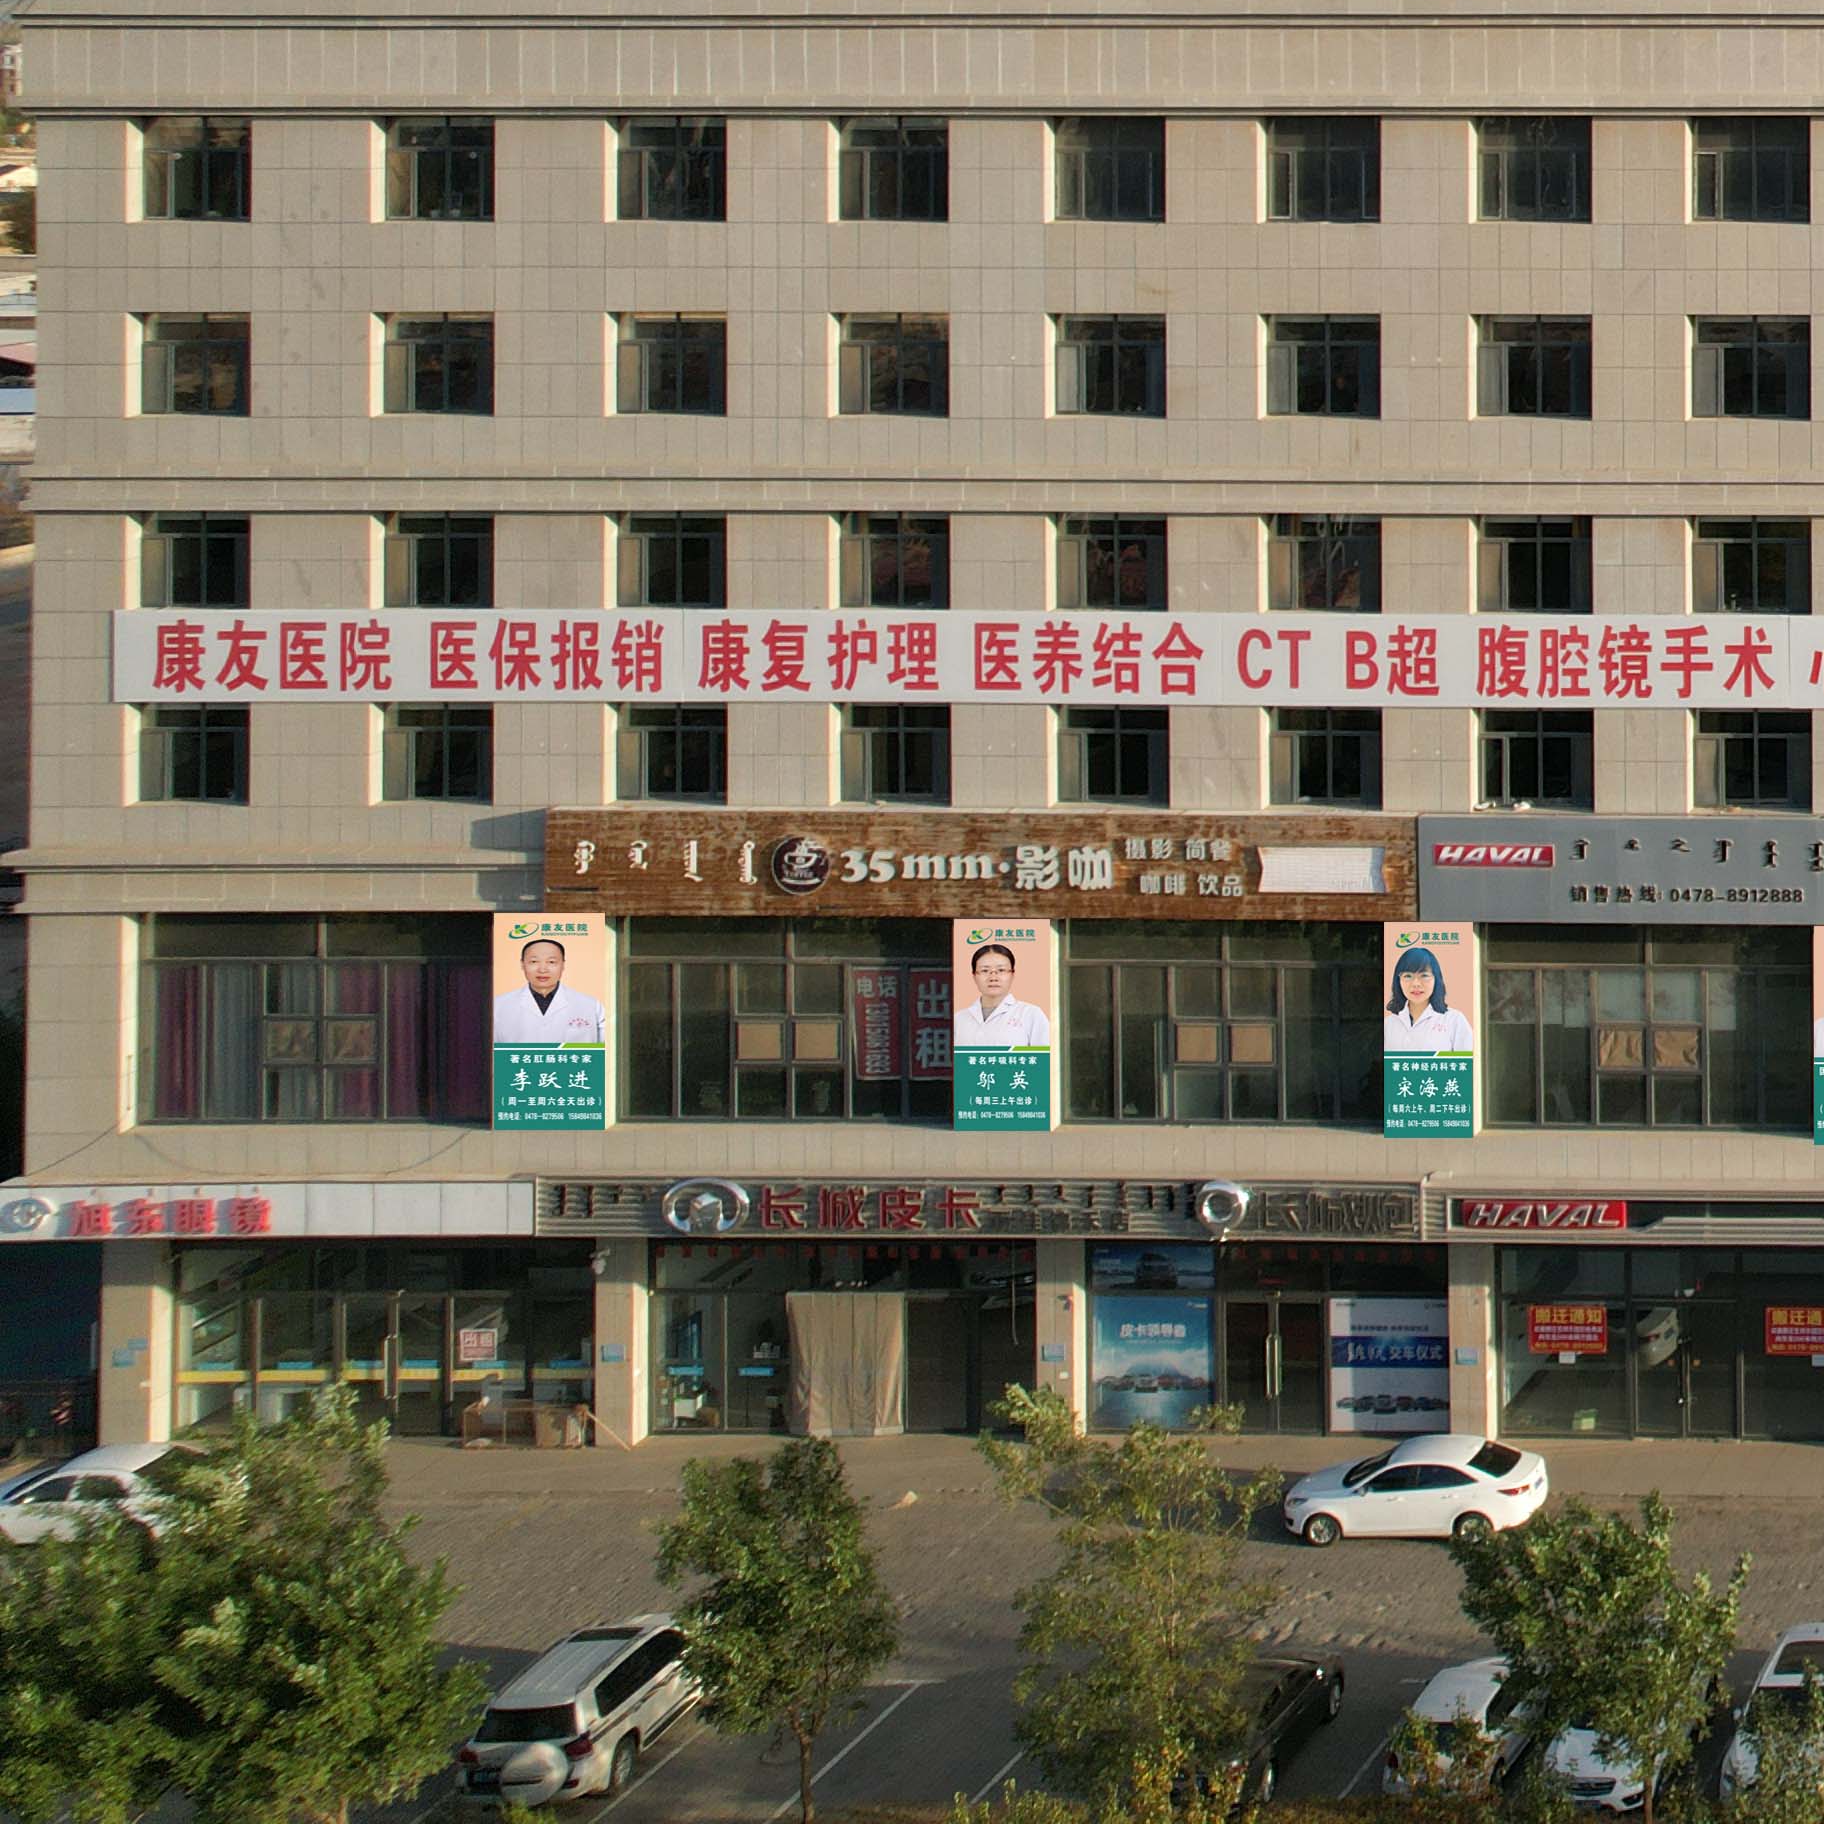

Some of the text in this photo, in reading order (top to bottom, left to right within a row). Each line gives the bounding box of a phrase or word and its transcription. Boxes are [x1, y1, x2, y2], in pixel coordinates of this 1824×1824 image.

[154, 619, 392, 693] 康友医院
[430, 619, 664, 693] 医保报销
[698, 619, 940, 693] 康复护理
[974, 621, 1204, 696] 医养结合
[1237, 628, 1312, 689] CT
[1345, 624, 1440, 697] B超
[1477, 623, 1775, 699] 腹腔镜手术
[1185, 840, 1233, 863] 简餐
[1436, 845, 1553, 866] HAVAL
[1140, 874, 1244, 897] 咖啡 饮品
[856, 975, 899, 999] 电话
[915, 979, 954, 1070] 出租
[510, 1054, 592, 1064] 著名肛肠科专家
[968, 1055, 1037, 1065] 著名呼吸科专家
[1392, 1061, 1468, 1072] 著名神经内科专家
[510, 1068, 591, 1092] 李跃进
[1397, 1076, 1462, 1098] 宋海燕
[69, 1196, 273, 1236] 旭东眼镜
[759, 1185, 983, 1231] 长城皮卡
[1466, 1201, 1624, 1229] HAVAL
